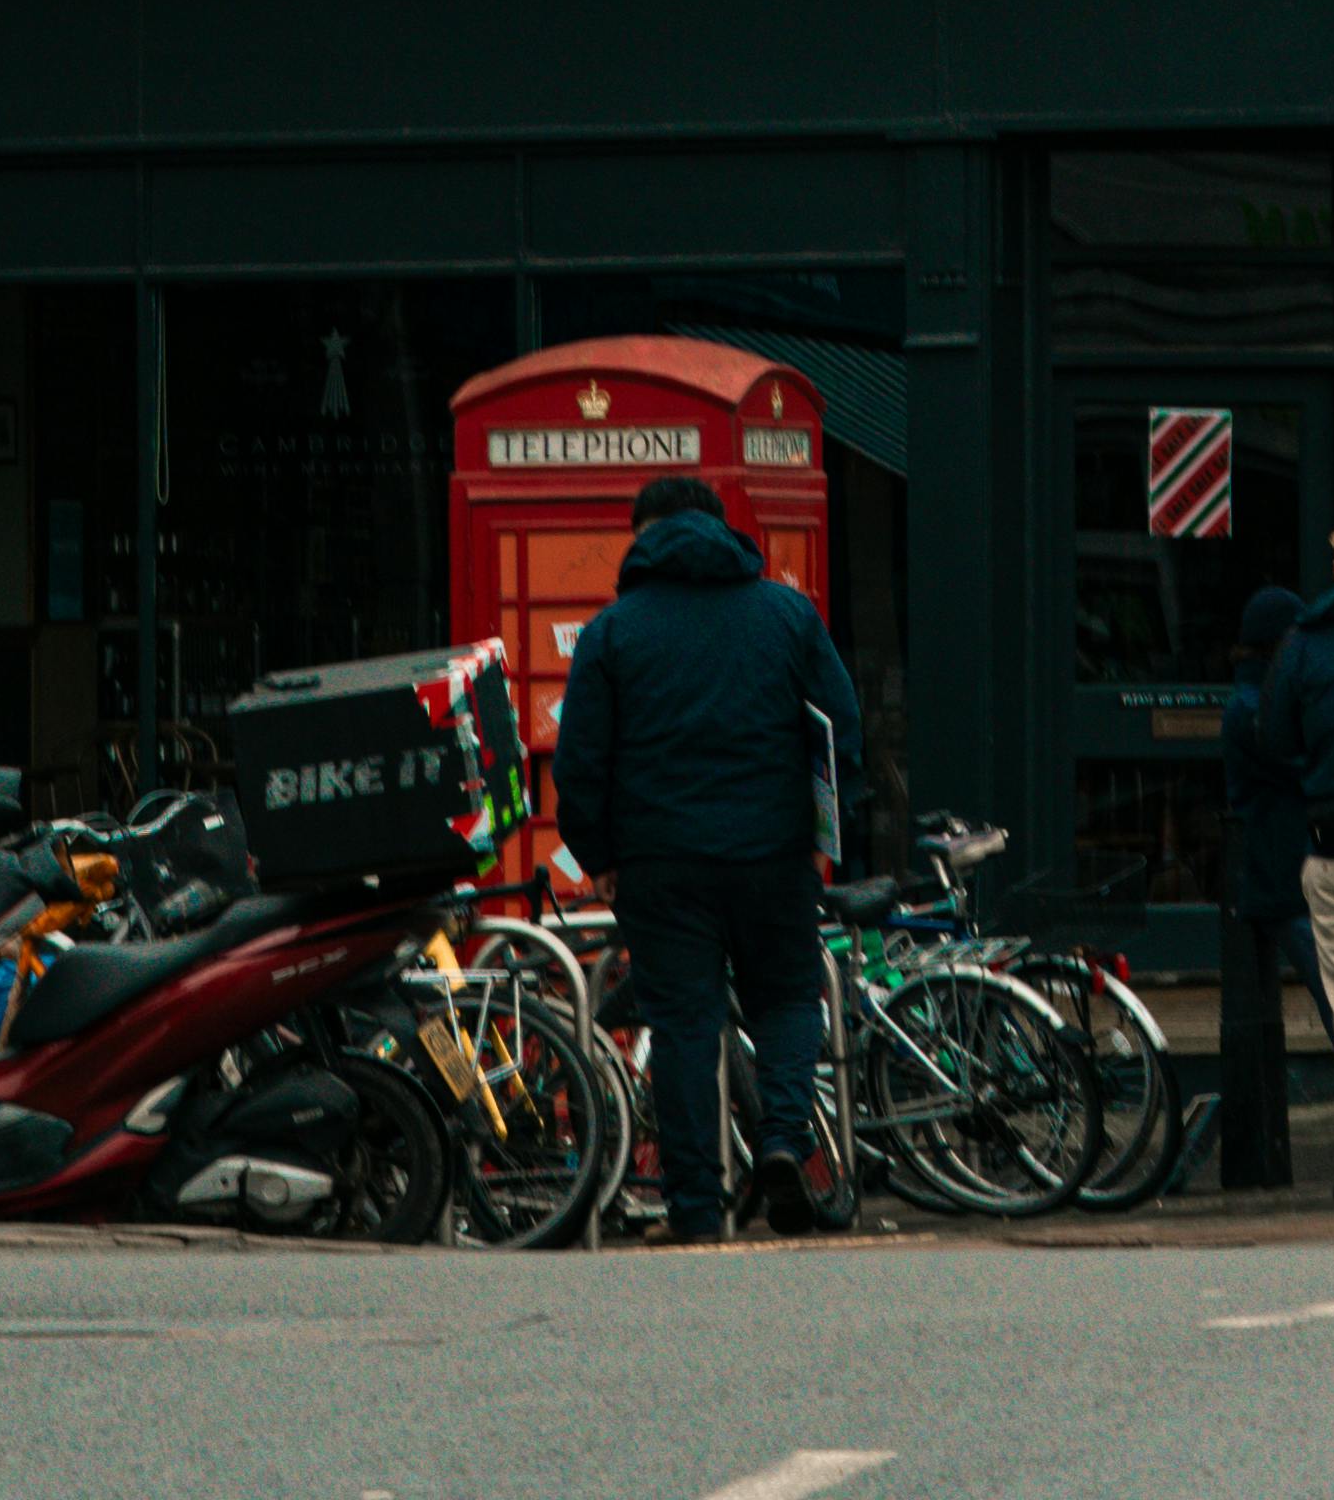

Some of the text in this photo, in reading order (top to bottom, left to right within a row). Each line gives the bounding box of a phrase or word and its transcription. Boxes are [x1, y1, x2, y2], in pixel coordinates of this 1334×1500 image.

[498, 427, 694, 463] TELEPHONE
[745, 428, 808, 460] TELEPHONE
[266, 746, 449, 810] BIKE IT
